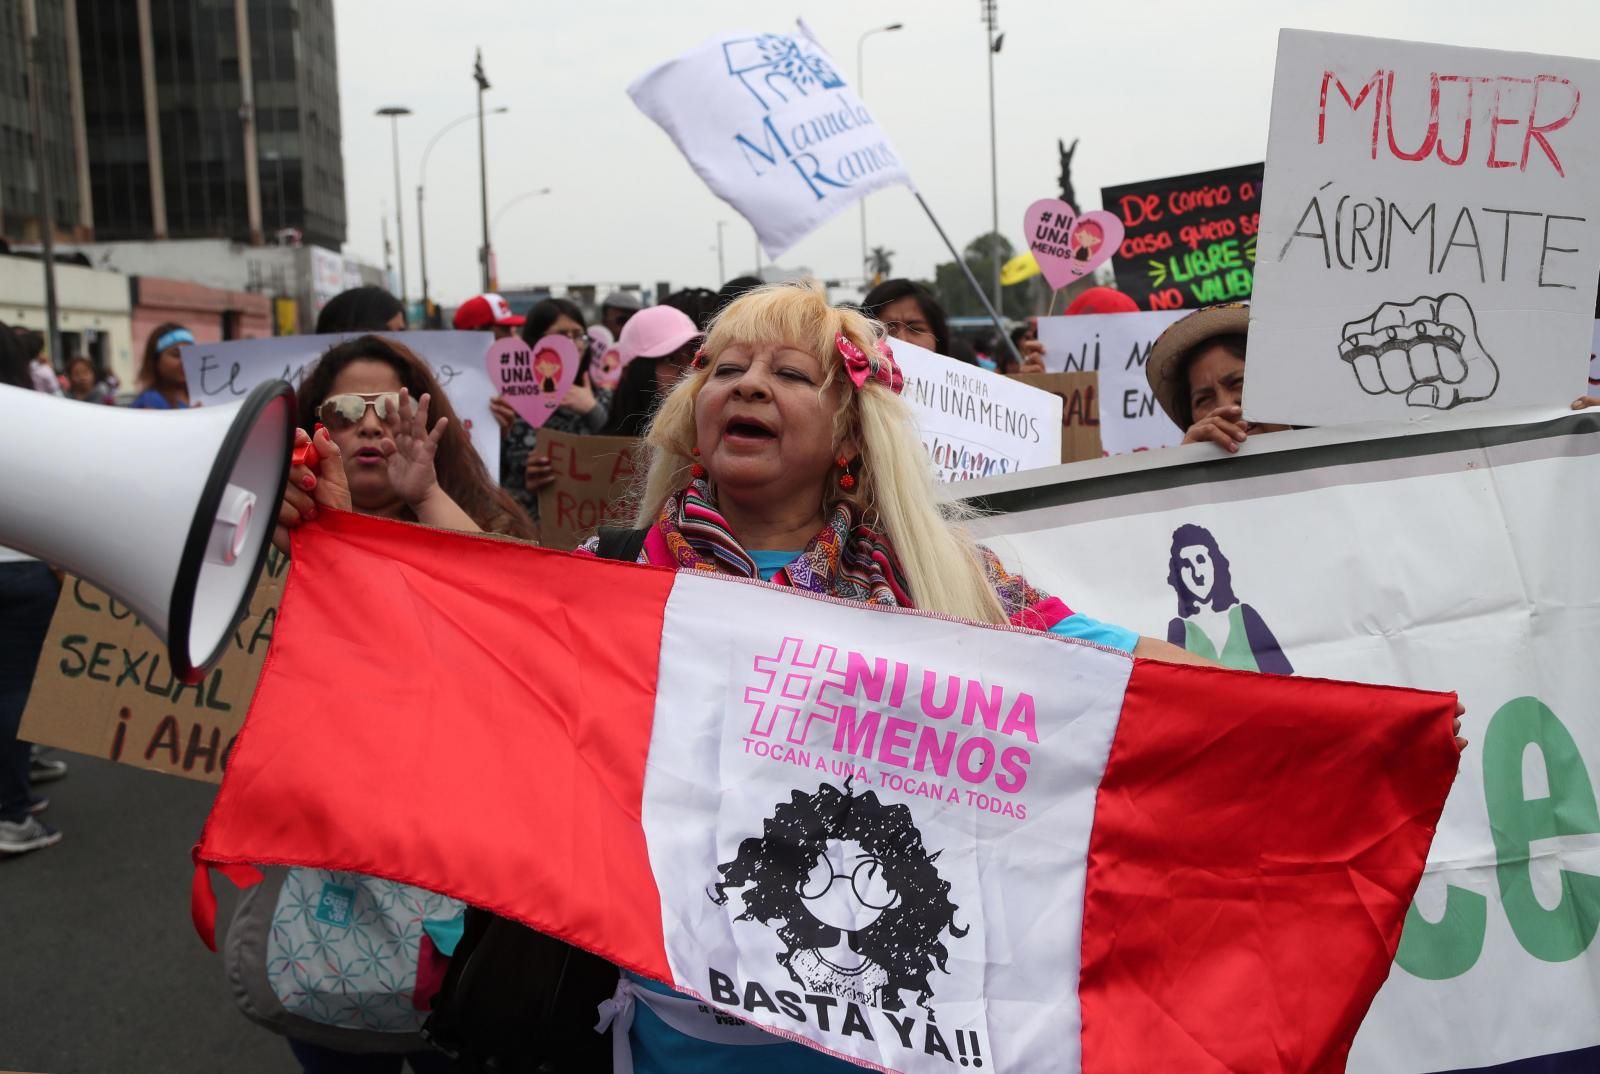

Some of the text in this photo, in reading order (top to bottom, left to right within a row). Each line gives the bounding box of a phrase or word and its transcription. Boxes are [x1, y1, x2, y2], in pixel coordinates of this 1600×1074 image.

[734, 98, 875, 176] Manuela
[1317, 69, 1581, 178] MUJER
[790, 142, 900, 200] Ramos
[1035, 227, 1070, 246] UNA
[1055, 213, 1073, 230] NI
[1030, 240, 1072, 260] MENOS
[1169, 240, 1242, 281] LIBRE
[1149, 288, 1183, 311] NO
[514, 351, 531, 364] NI
[501, 368, 533, 384] UNA
[502, 384, 540, 397] MENOS
[945, 370, 989, 398] MARCHA
[920, 670, 1039, 745] UNA
[832, 705, 1031, 794] MENOS
[743, 737, 811, 769] TOCAN
[815, 757, 828, 773] A
[880, 772, 943, 801] TOCAN
[947, 788, 960, 804] A
[967, 790, 1027, 821] TODAS
[708, 967, 875, 1041] BASTA
